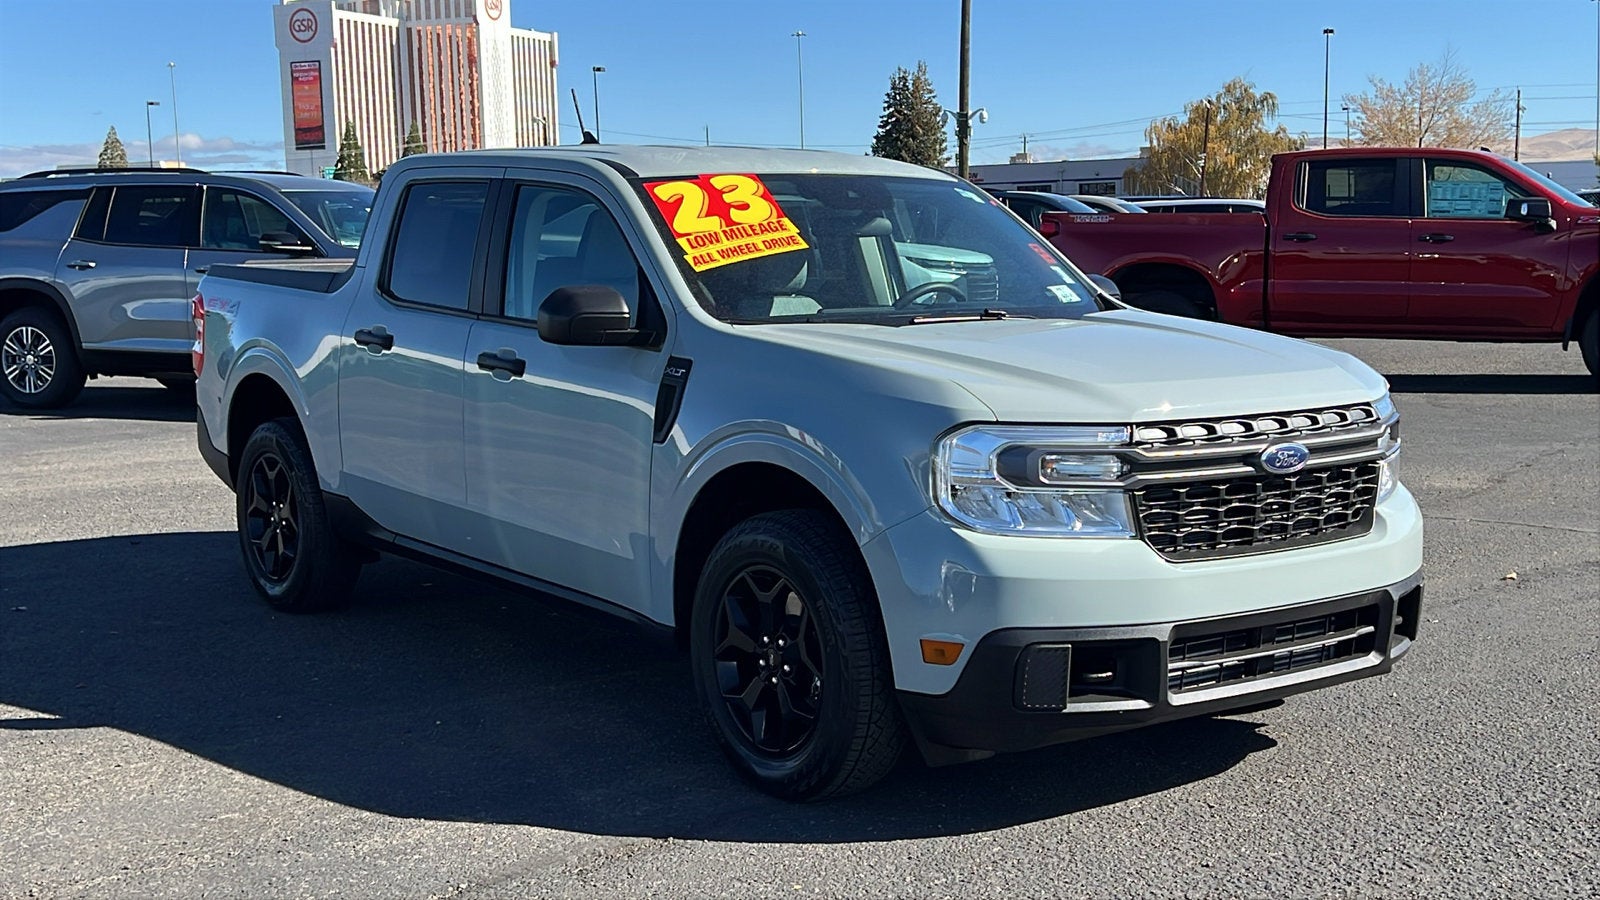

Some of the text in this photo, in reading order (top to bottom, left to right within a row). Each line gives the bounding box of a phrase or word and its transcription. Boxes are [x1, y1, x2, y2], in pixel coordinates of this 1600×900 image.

[292, 18, 314, 33] GSR
[653, 174, 777, 234] 23
[686, 219, 788, 250] LOW MILEAGE
[692, 235, 800, 267] ALL WHEEL DRIVE
[664, 367, 686, 377] XLT
[1272, 450, 1301, 467] Ford
